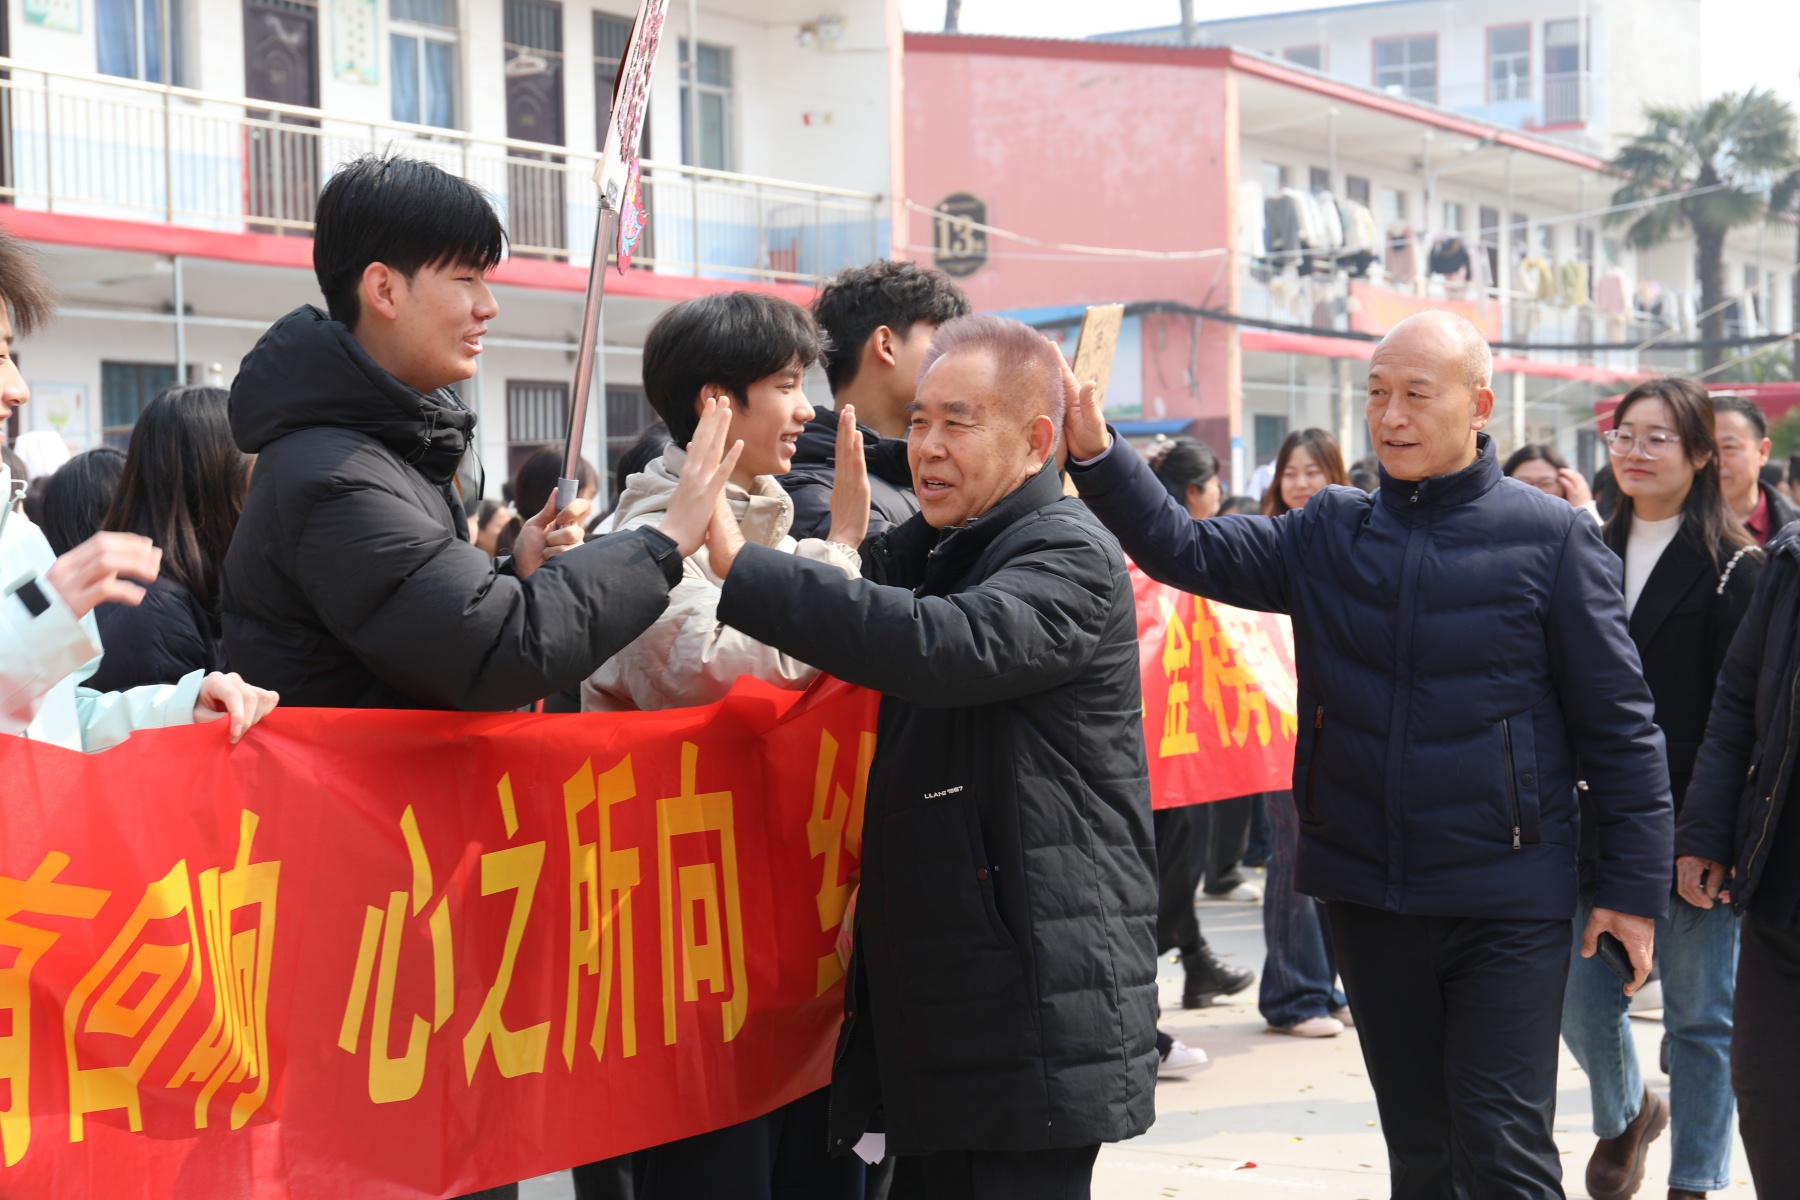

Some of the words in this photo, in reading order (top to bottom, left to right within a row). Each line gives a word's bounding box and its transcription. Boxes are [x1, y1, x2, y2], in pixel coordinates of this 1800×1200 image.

[1158, 594, 1297, 758] 金榜
[338, 740, 747, 1104] 心之所向
